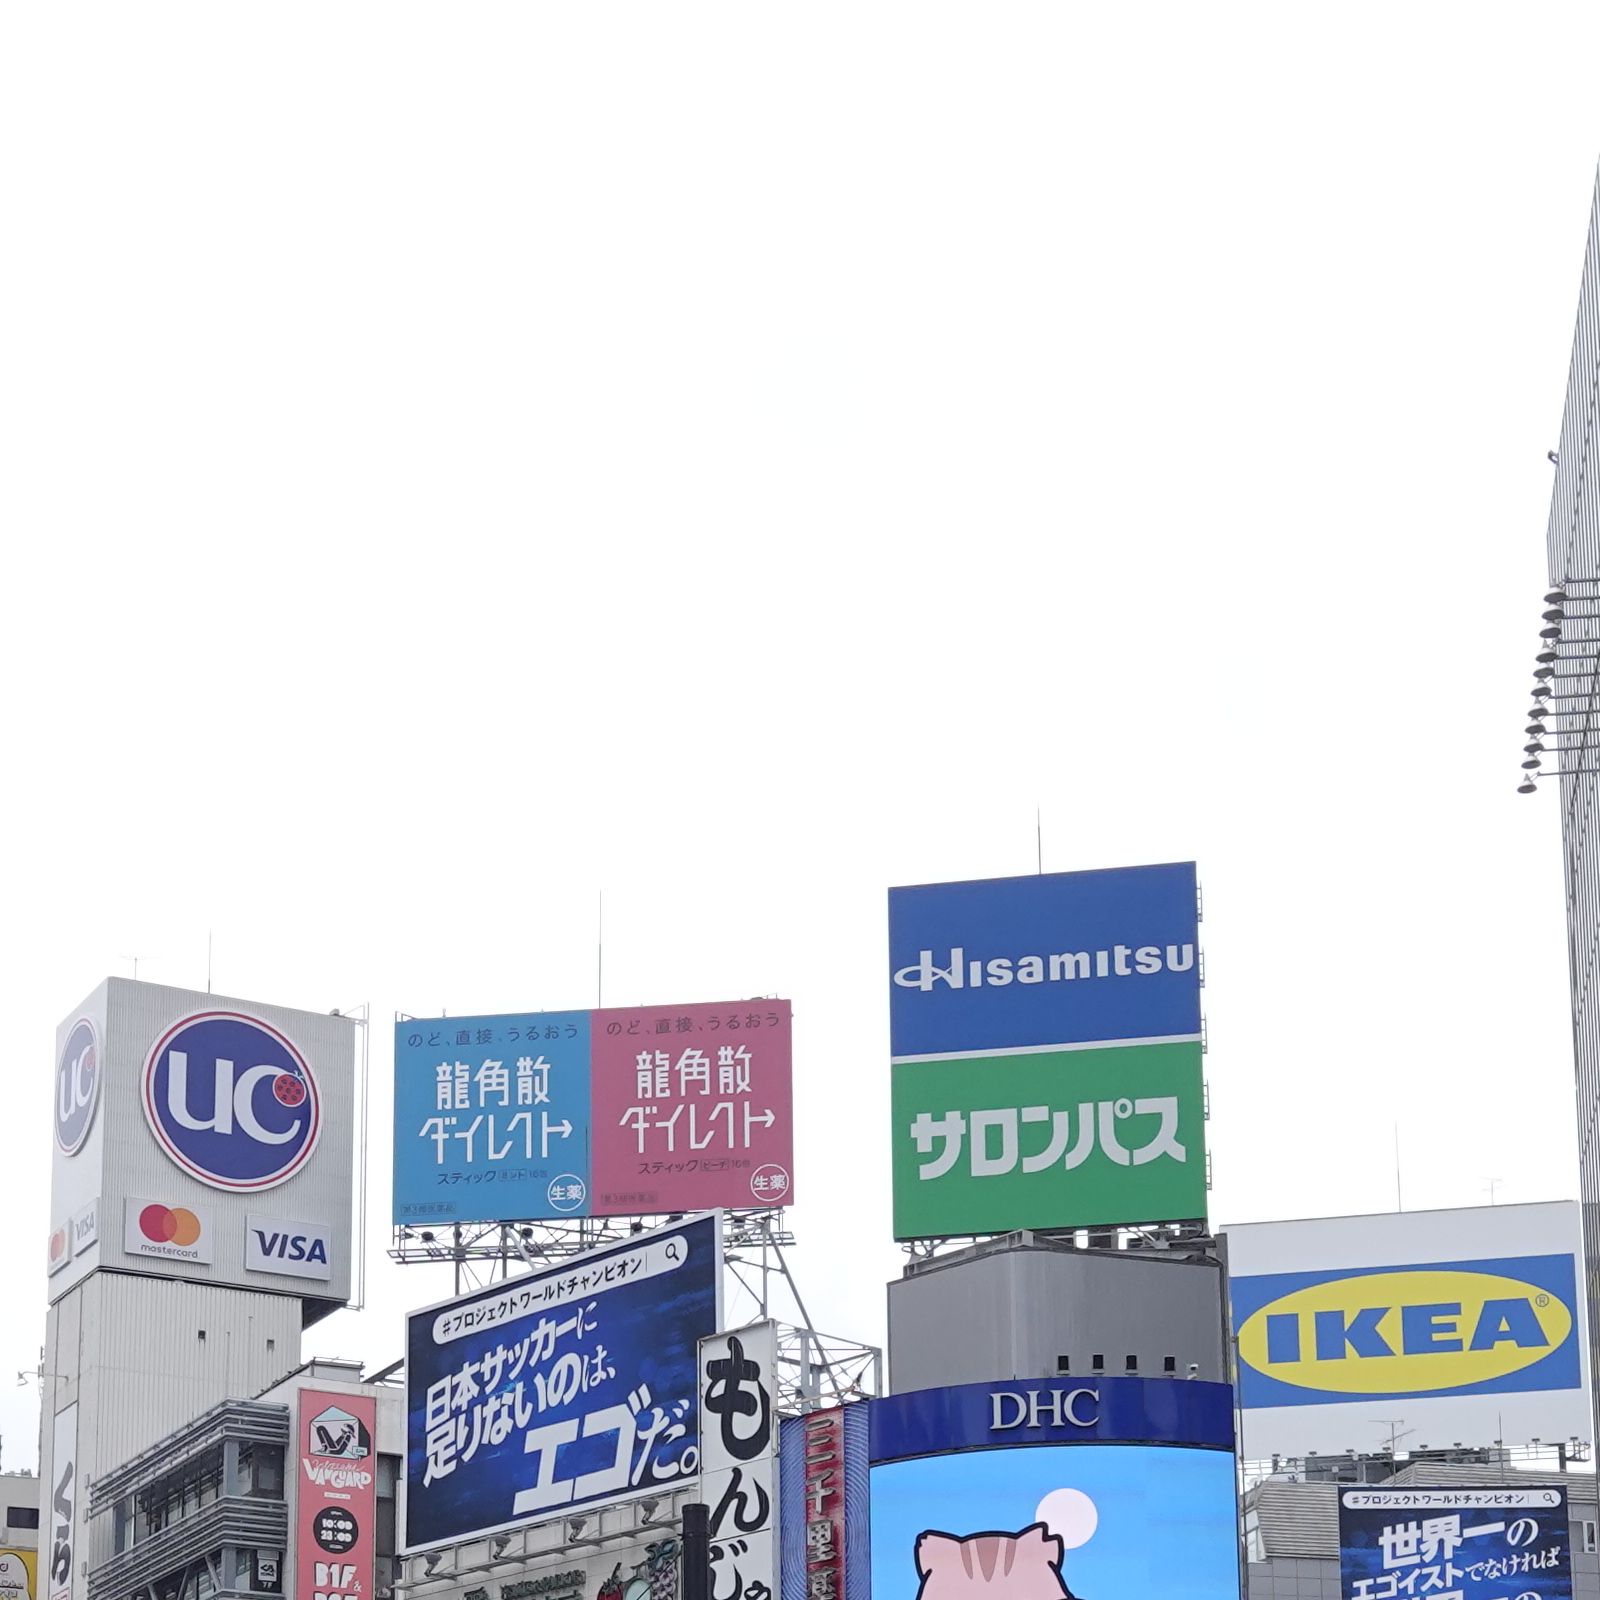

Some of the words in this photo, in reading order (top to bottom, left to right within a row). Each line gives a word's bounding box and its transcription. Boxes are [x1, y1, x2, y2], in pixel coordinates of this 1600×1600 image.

[893, 942, 1195, 993] Hisamitsu
[435, 1054, 551, 1111] 龍角散
[635, 1044, 753, 1100] 龍角散
[418, 1111, 574, 1165] ダイレクト
[618, 1100, 776, 1154] ダイレクト
[909, 1095, 1187, 1181] サロンパス
[436, 1169, 497, 1186] スティック
[550, 1183, 584, 1201] 生薬
[638, 1159, 698, 1175] スティック
[753, 1174, 787, 1192] 生薬
[140, 1243, 199, 1260] mastercard
[251, 1228, 328, 1265] VISA
[441, 1255, 643, 1337] #プロジェクトワールドチャンピオン
[425, 1300, 598, 1433] 日本サッカーに
[422, 1343, 618, 1489] 足りないのは、
[989, 1387, 1101, 1430] DHC
[512, 1383, 699, 1516] エゴだ。
[1350, 1492, 1525, 1507] #プロジェクトワールドチャンピオン
[1378, 1514, 1539, 1570] 世界一の
[314, 1561, 358, 1589] B1F
